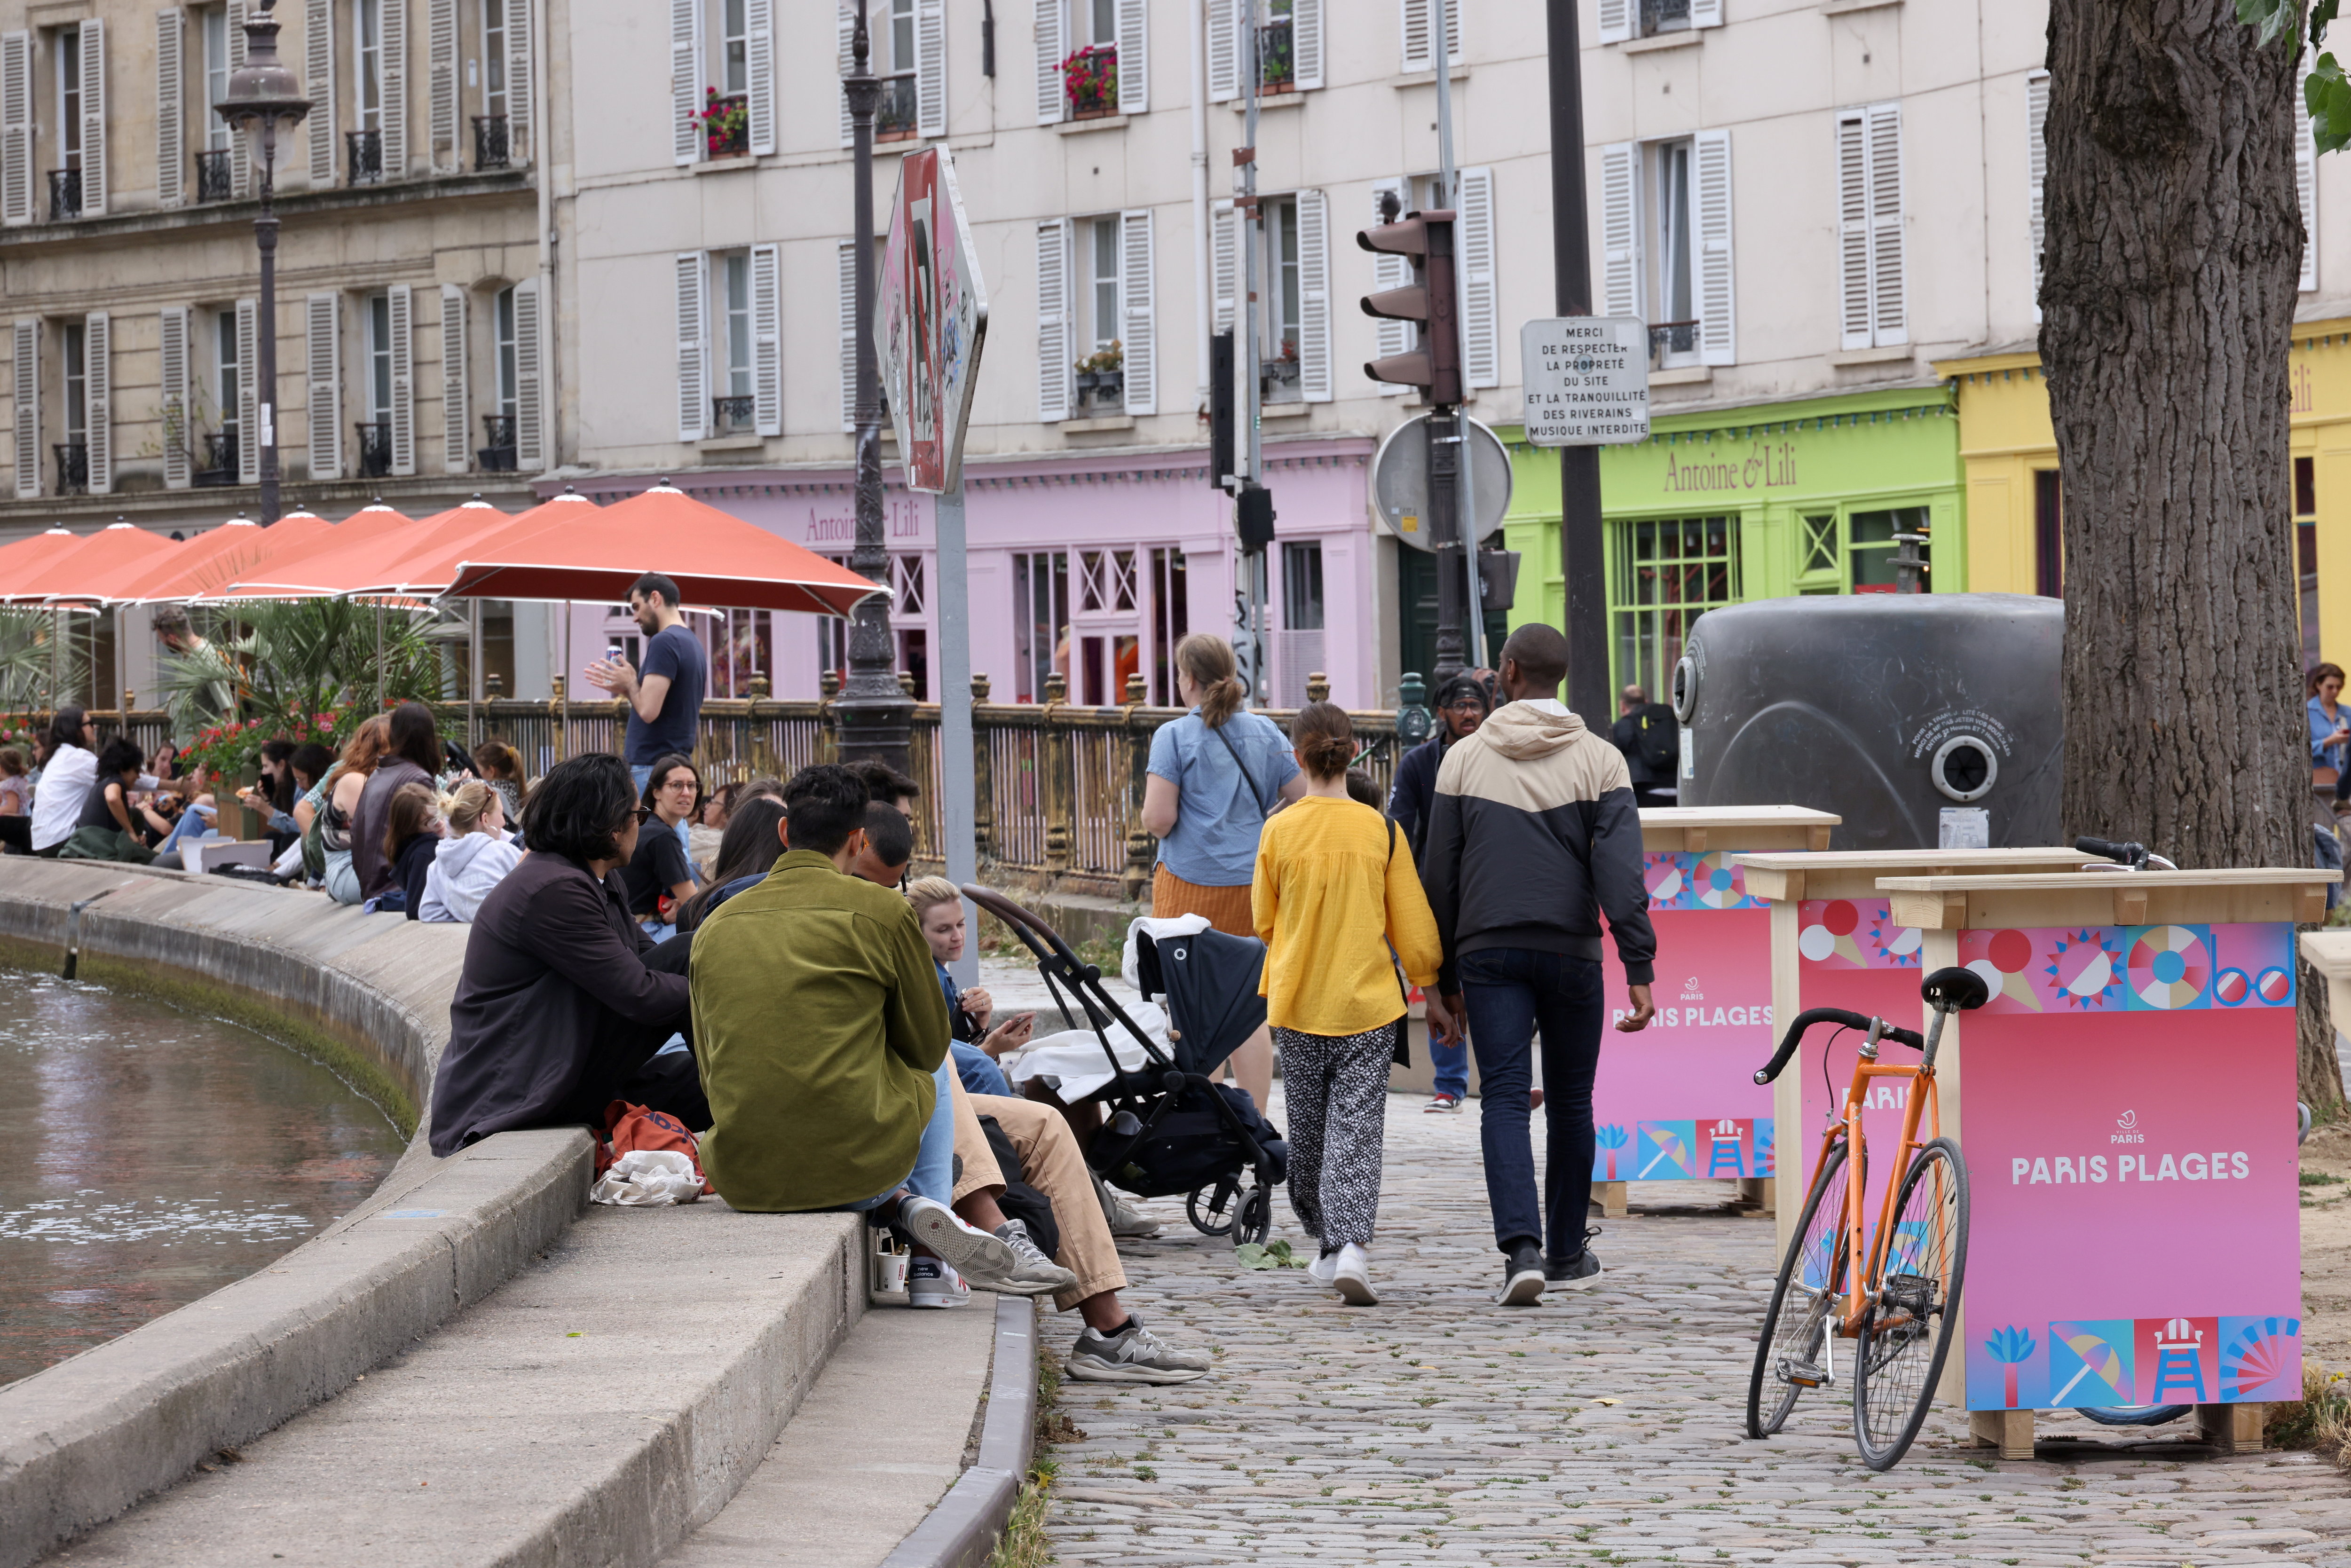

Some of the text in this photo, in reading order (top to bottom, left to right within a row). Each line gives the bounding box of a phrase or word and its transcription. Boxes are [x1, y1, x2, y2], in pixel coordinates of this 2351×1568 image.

[1567, 328, 1603, 338] MERCI
[1543, 344, 1628, 355] DE RESPECTER
[1546, 358, 1624, 370] LA PROPRETÉ
[1564, 377, 1609, 386] DU SITE
[2290, 363, 2312, 412] ili
[1528, 389, 1645, 404] ET LA TRANQUILLITÉ
[1543, 408, 1632, 419] DES RIVERAINS
[1530, 424, 1647, 436] MUSIQUE INTERDITE
[1664, 452, 1738, 492] Antoine
[1764, 442, 1797, 487] Lili
[806, 499, 919, 541] Antoin Lili
[1914, 738, 1927, 758] MERCI
[1925, 730, 1934, 739] DE
[1925, 733, 1942, 751] ENTRE
[1686, 1005, 1773, 1026] PLAGES
[1842, 1087, 1910, 1110] PARI
[2111, 1134, 2145, 1143] PARIS
[2012, 1151, 2250, 1185] PARIS PLAGES
